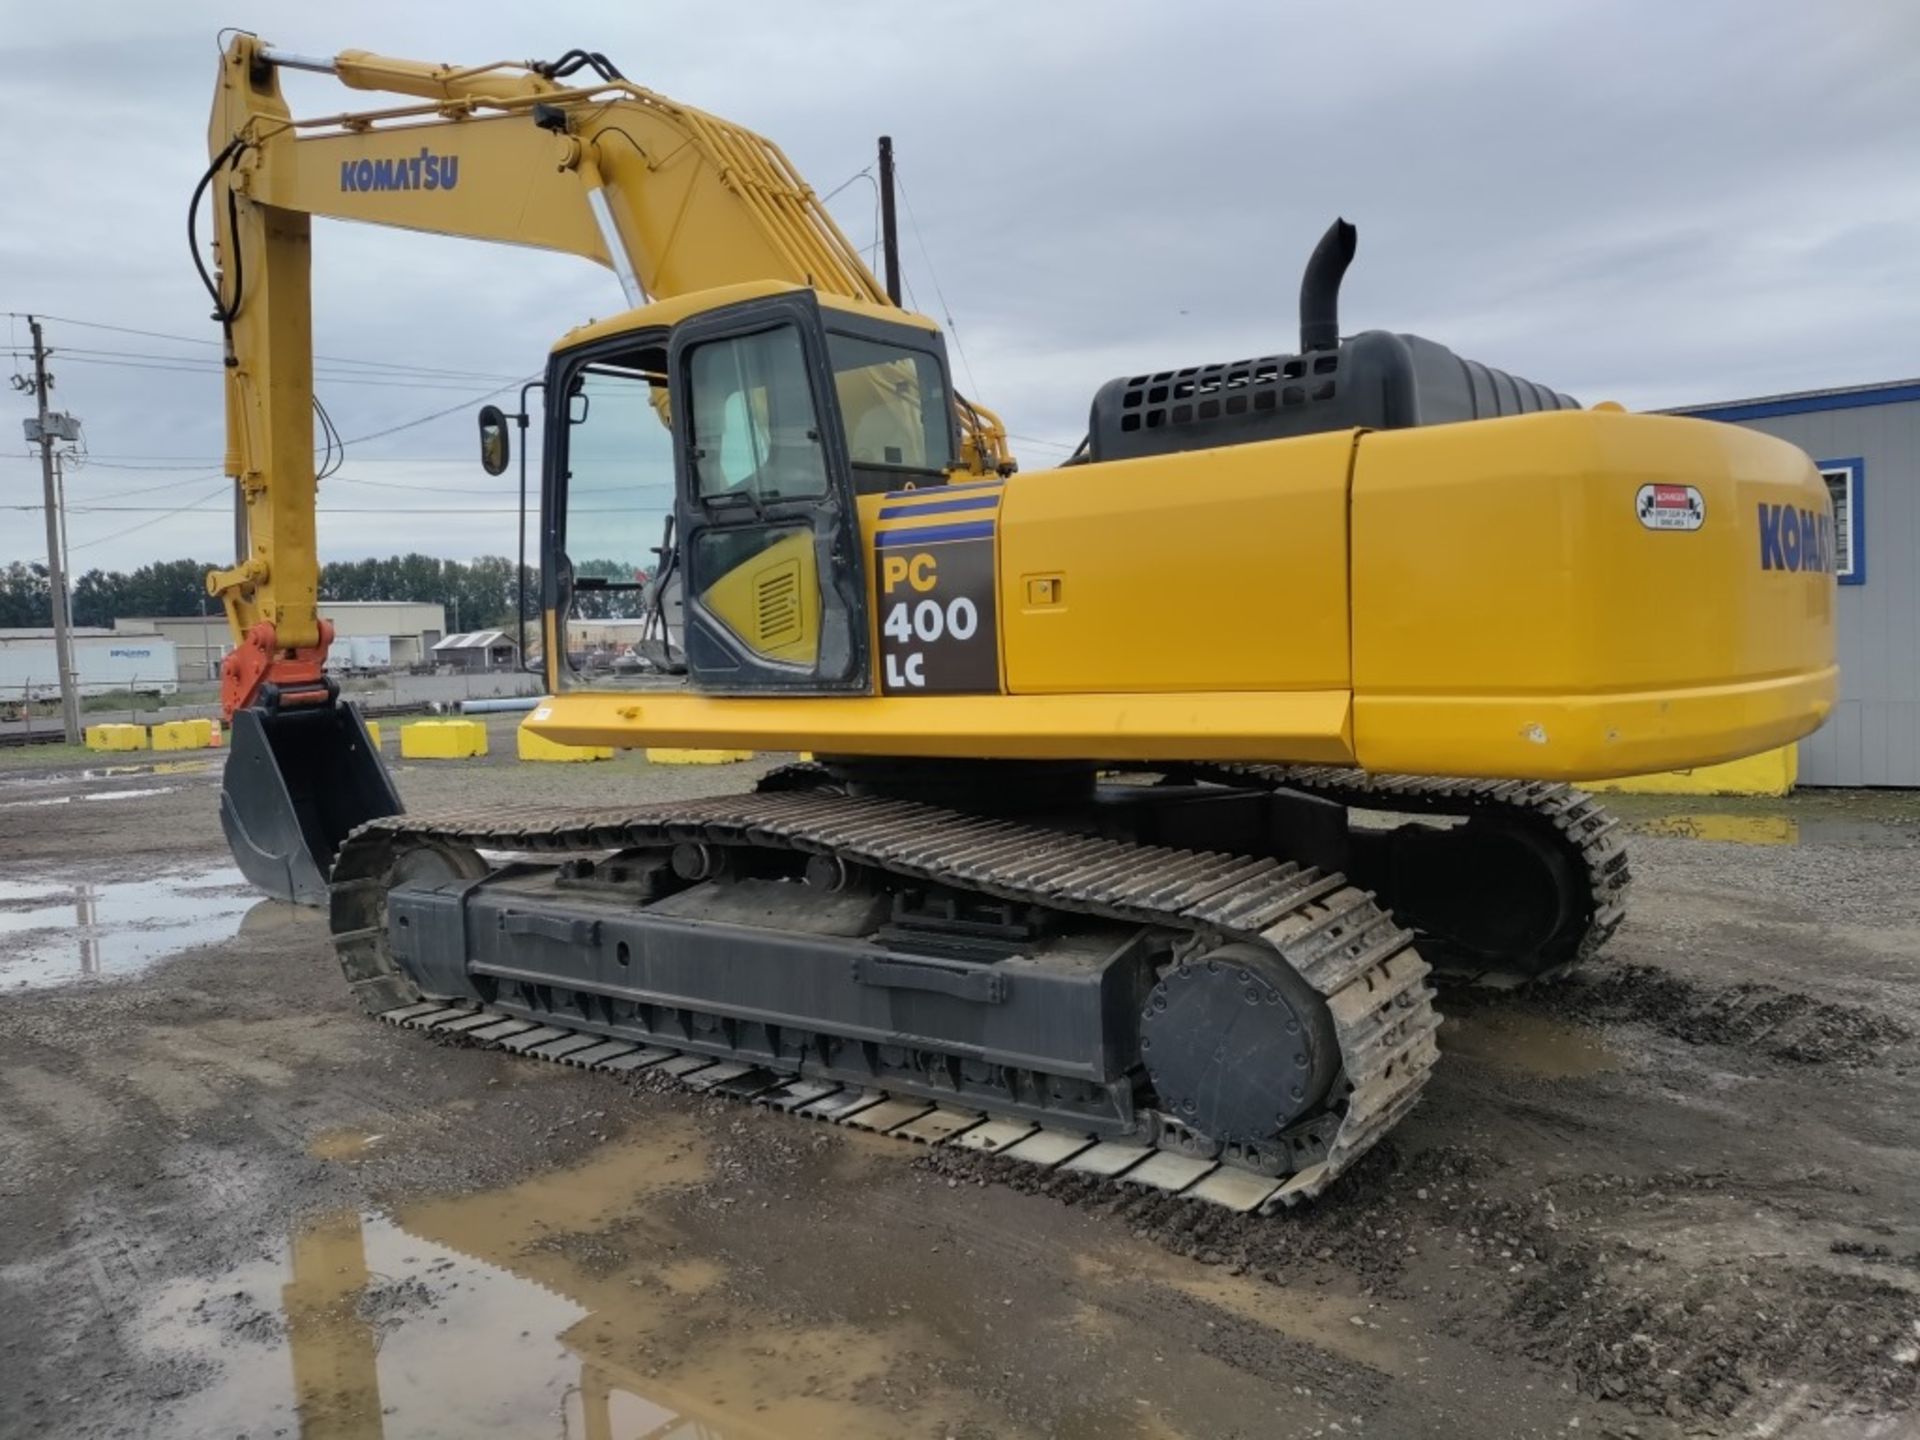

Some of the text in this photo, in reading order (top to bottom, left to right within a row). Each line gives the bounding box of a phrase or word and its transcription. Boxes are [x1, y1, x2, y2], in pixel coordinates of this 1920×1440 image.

[341, 146, 458, 192] KOMATSU
[883, 552, 937, 593] PC
[884, 597, 978, 643] 400
[886, 652, 925, 687] LC
